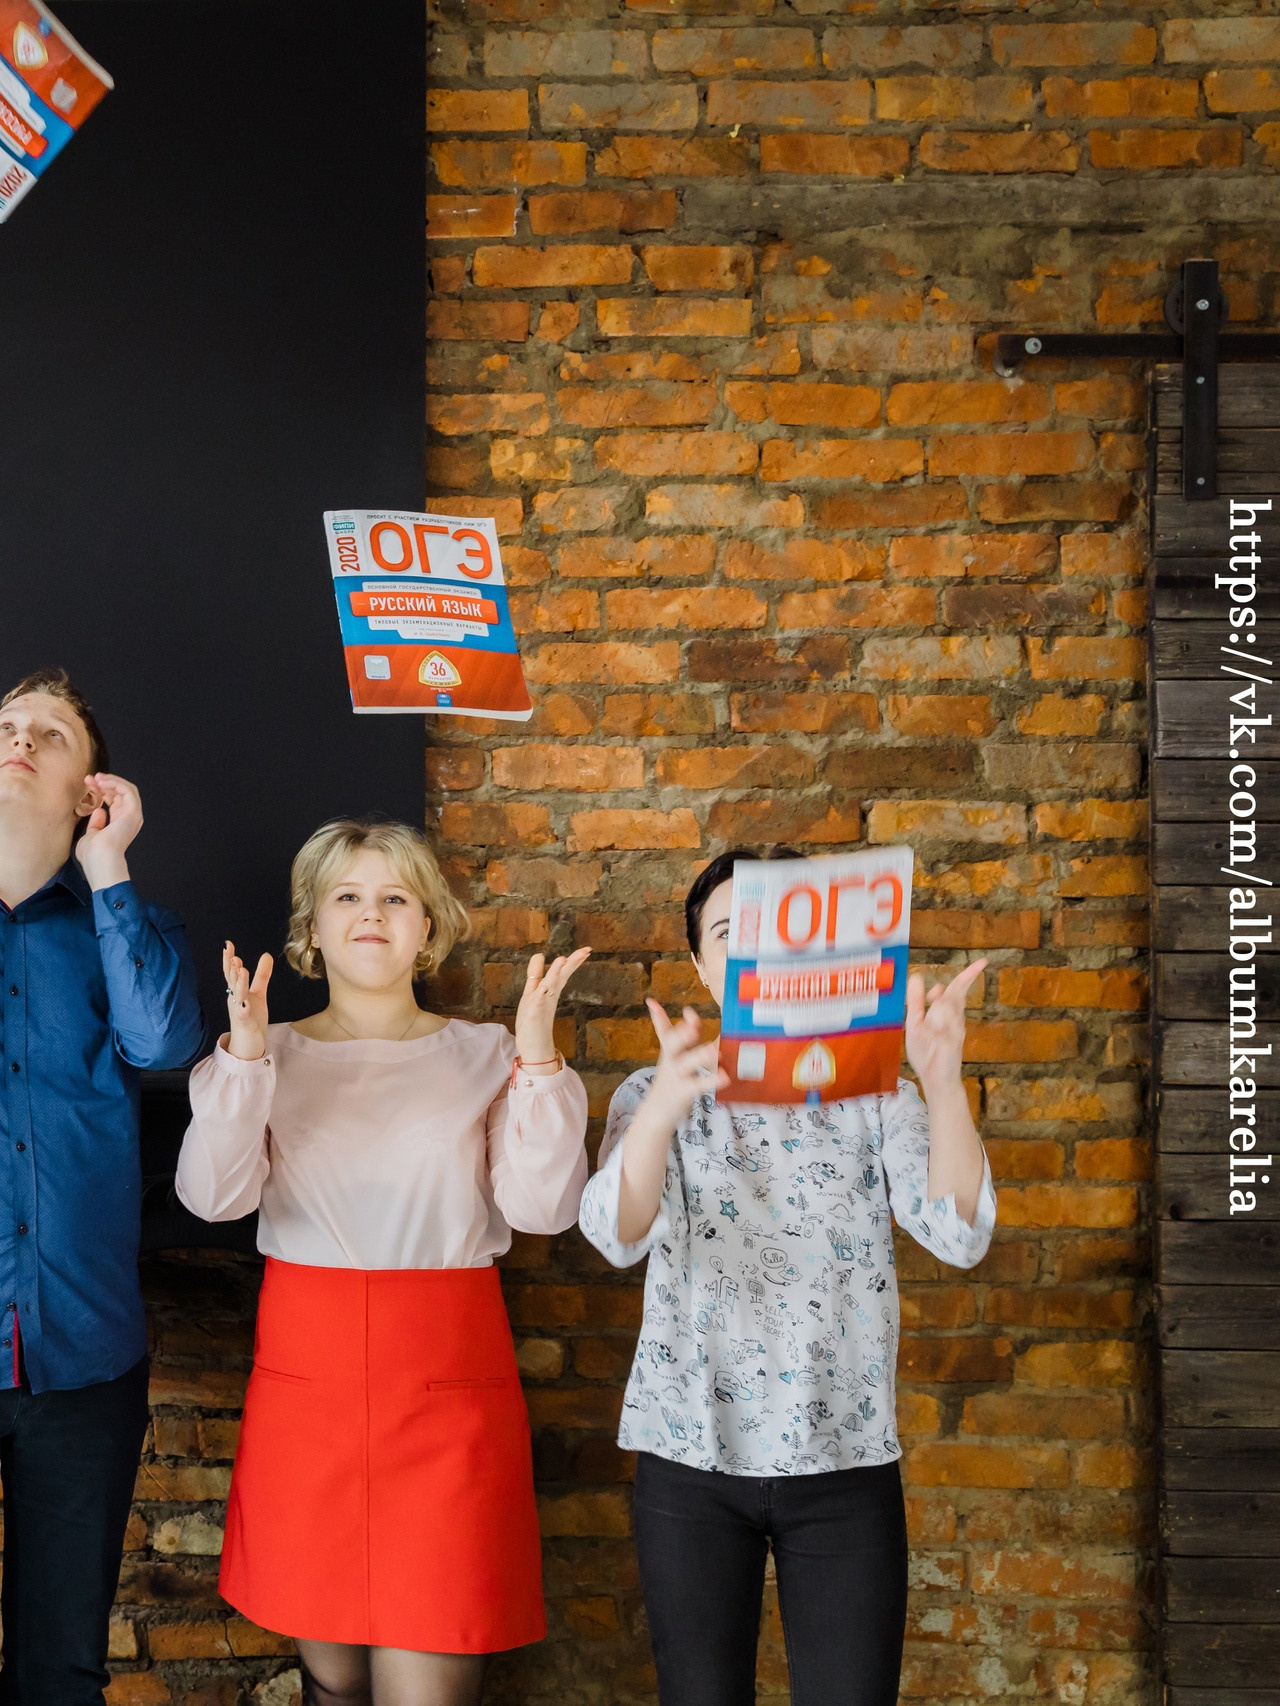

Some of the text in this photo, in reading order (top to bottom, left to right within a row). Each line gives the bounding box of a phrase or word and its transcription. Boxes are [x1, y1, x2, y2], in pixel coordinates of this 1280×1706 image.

[336, 536, 361, 573] 2020
[369, 521, 493, 579] ОГЭ
[369, 595, 483, 617] РУССКИЙ ЯЗЫК
[429, 661, 446, 676] 36
[777, 871, 904, 951] ОГЭ
[763, 1252, 784, 1264] hello
[764, 1314, 784, 1328] YOUR
